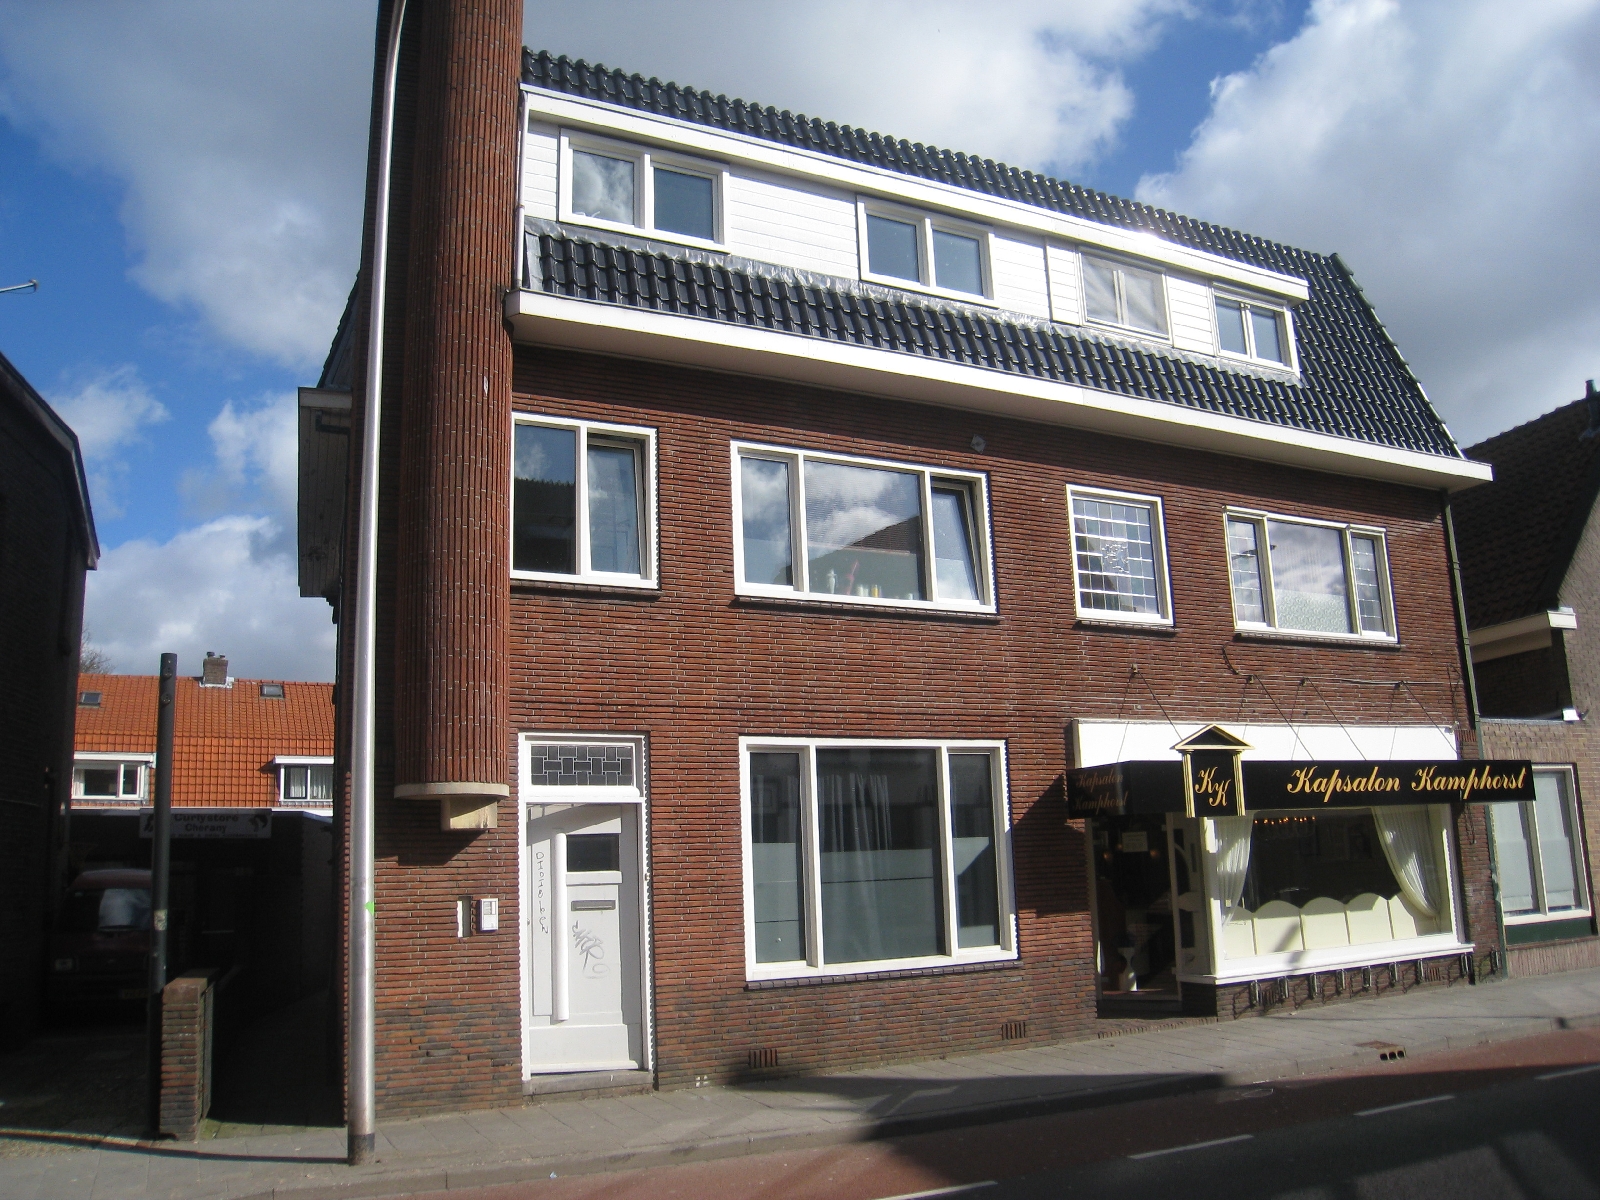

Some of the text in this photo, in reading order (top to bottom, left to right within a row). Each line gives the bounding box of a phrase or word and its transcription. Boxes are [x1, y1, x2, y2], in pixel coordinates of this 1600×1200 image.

[1076, 769, 1123, 793] Kapsalon
[1286, 765, 1525, 803] Kapsalon Kamphorst
[174, 814, 239, 824] Curlystore
